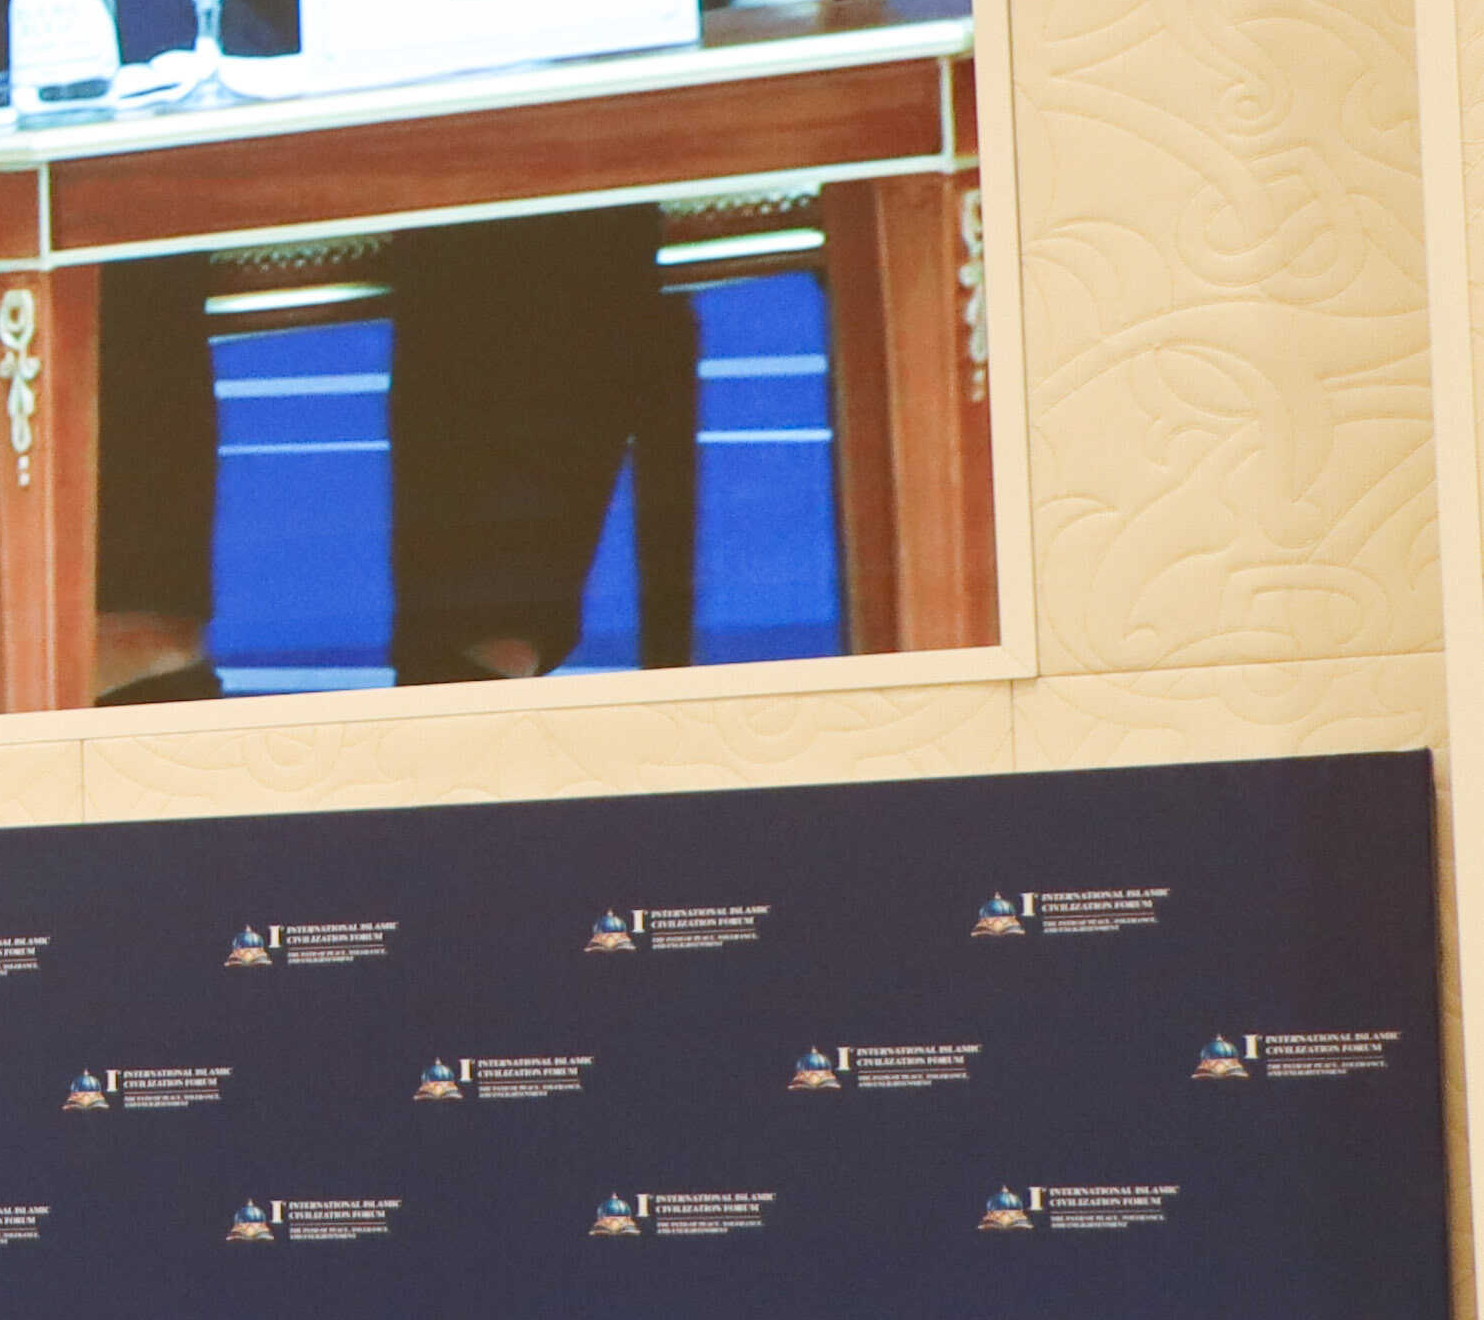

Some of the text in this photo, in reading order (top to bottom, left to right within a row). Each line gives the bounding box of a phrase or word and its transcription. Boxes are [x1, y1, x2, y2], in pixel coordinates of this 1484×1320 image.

[1265, 1031, 1400, 1044] INTERNATIONAL ISLAMIC
[856, 1044, 980, 1056] INTERNATIONAL ISLAMIC
[1265, 1044, 1382, 1055] CIVILIZATION FORUM
[856, 1056, 964, 1067] CIVILIZATION FORUM
[123, 1067, 231, 1078] INTERNATIONAL ISLAMIC
[122, 1078, 217, 1088] CIVILIZATION FORUM
[1049, 1186, 1178, 1196] INTERNATIONAL ISLAMIC
[1049, 1197, 1161, 1207] CIVILIZATION FORUM
